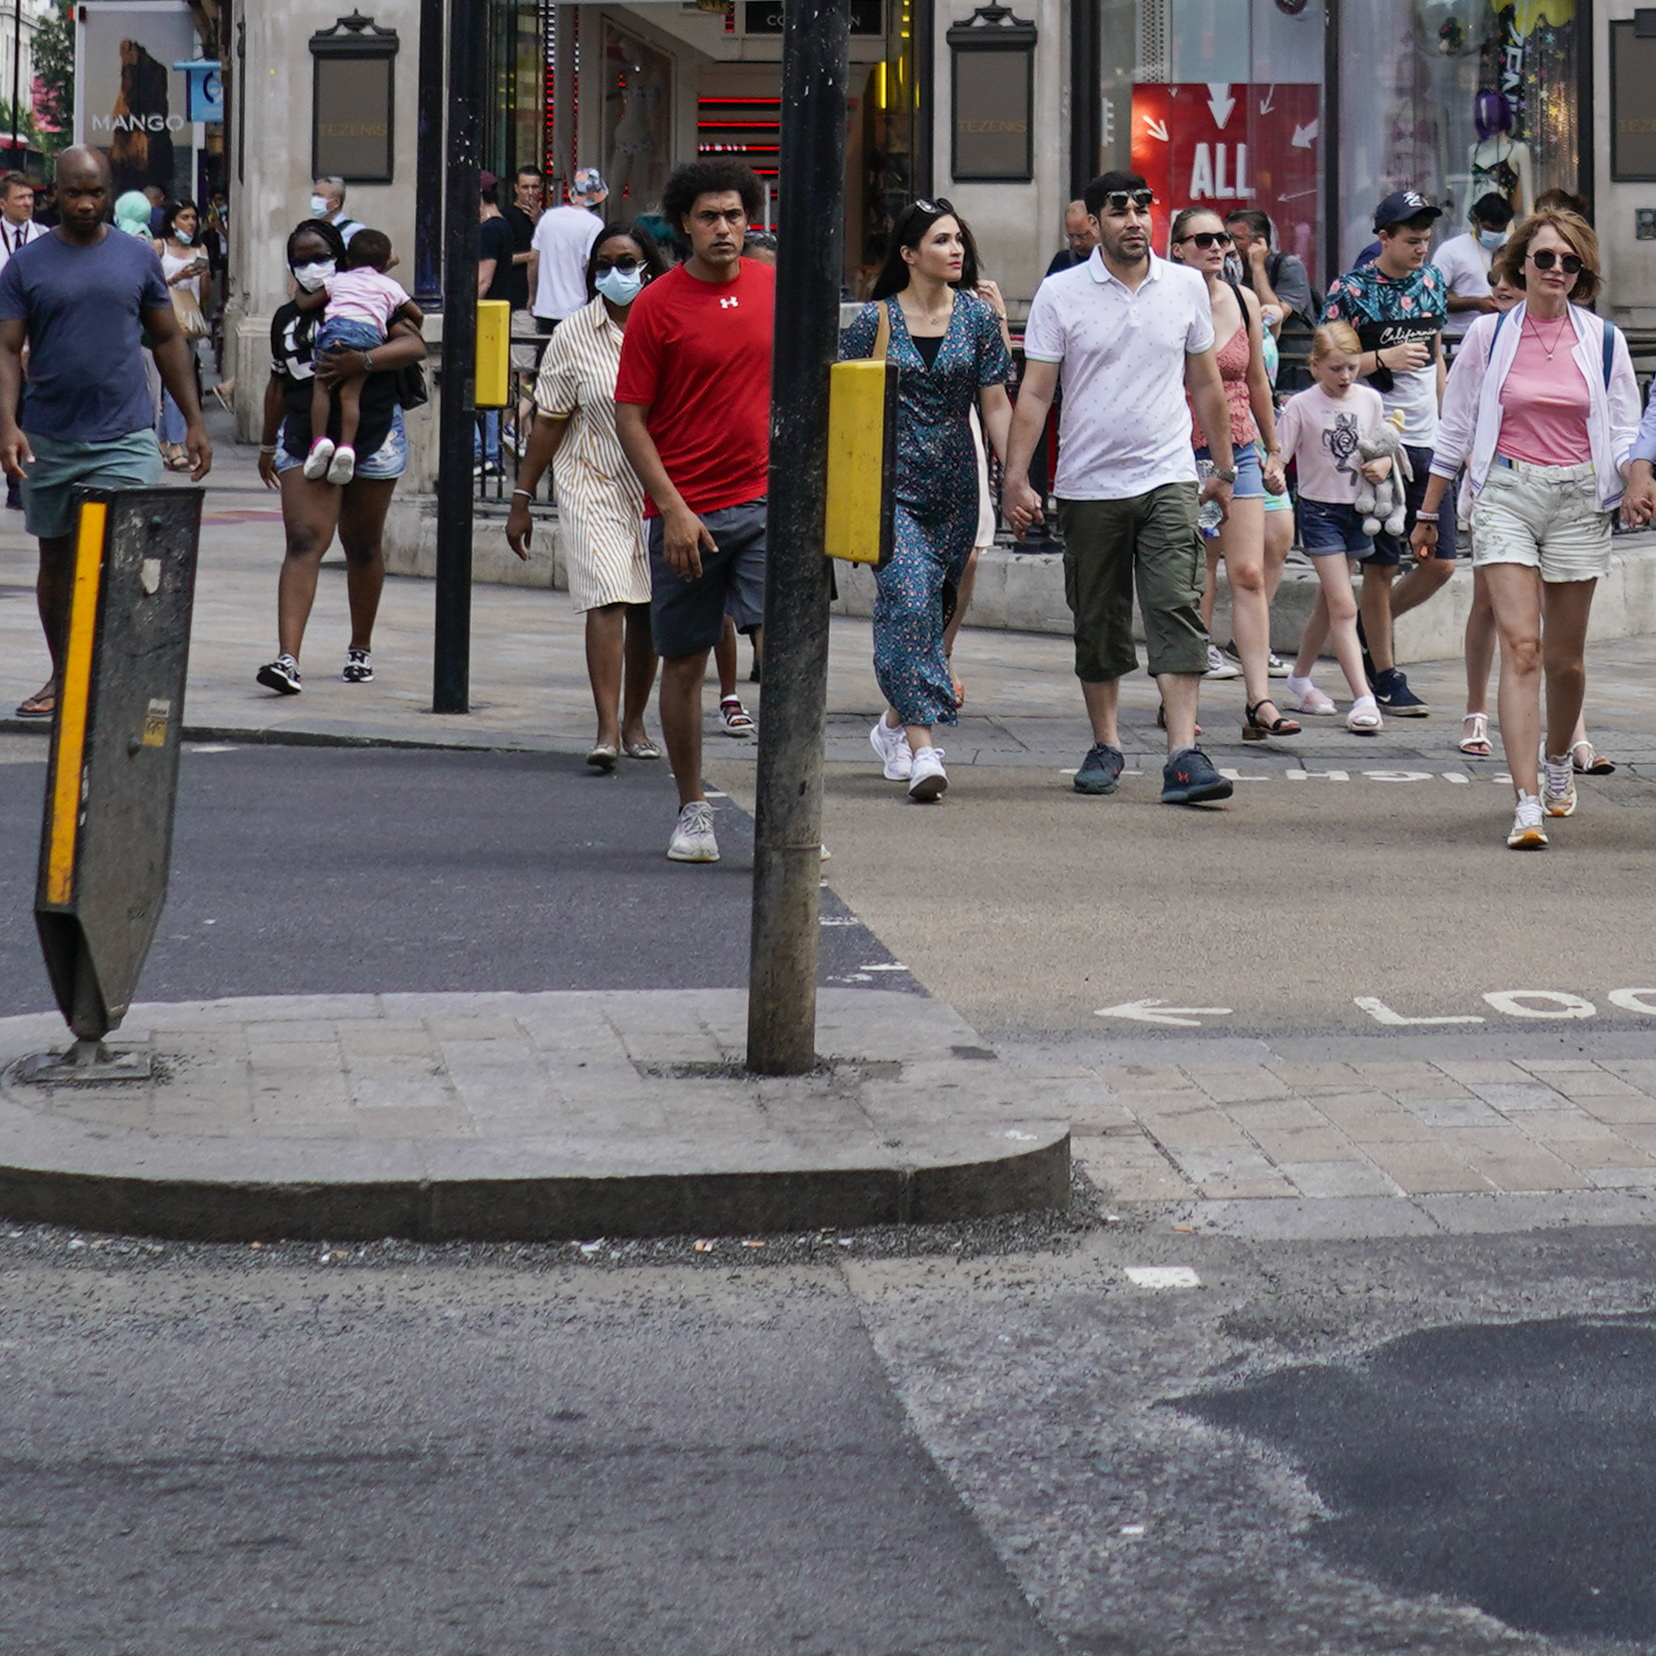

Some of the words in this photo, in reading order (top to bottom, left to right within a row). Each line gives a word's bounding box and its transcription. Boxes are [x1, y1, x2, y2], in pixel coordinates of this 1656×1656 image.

[91, 114, 185, 132] MANGO
[1190, 142, 1255, 200] ALL
[1379, 326, 1438, 345] California
